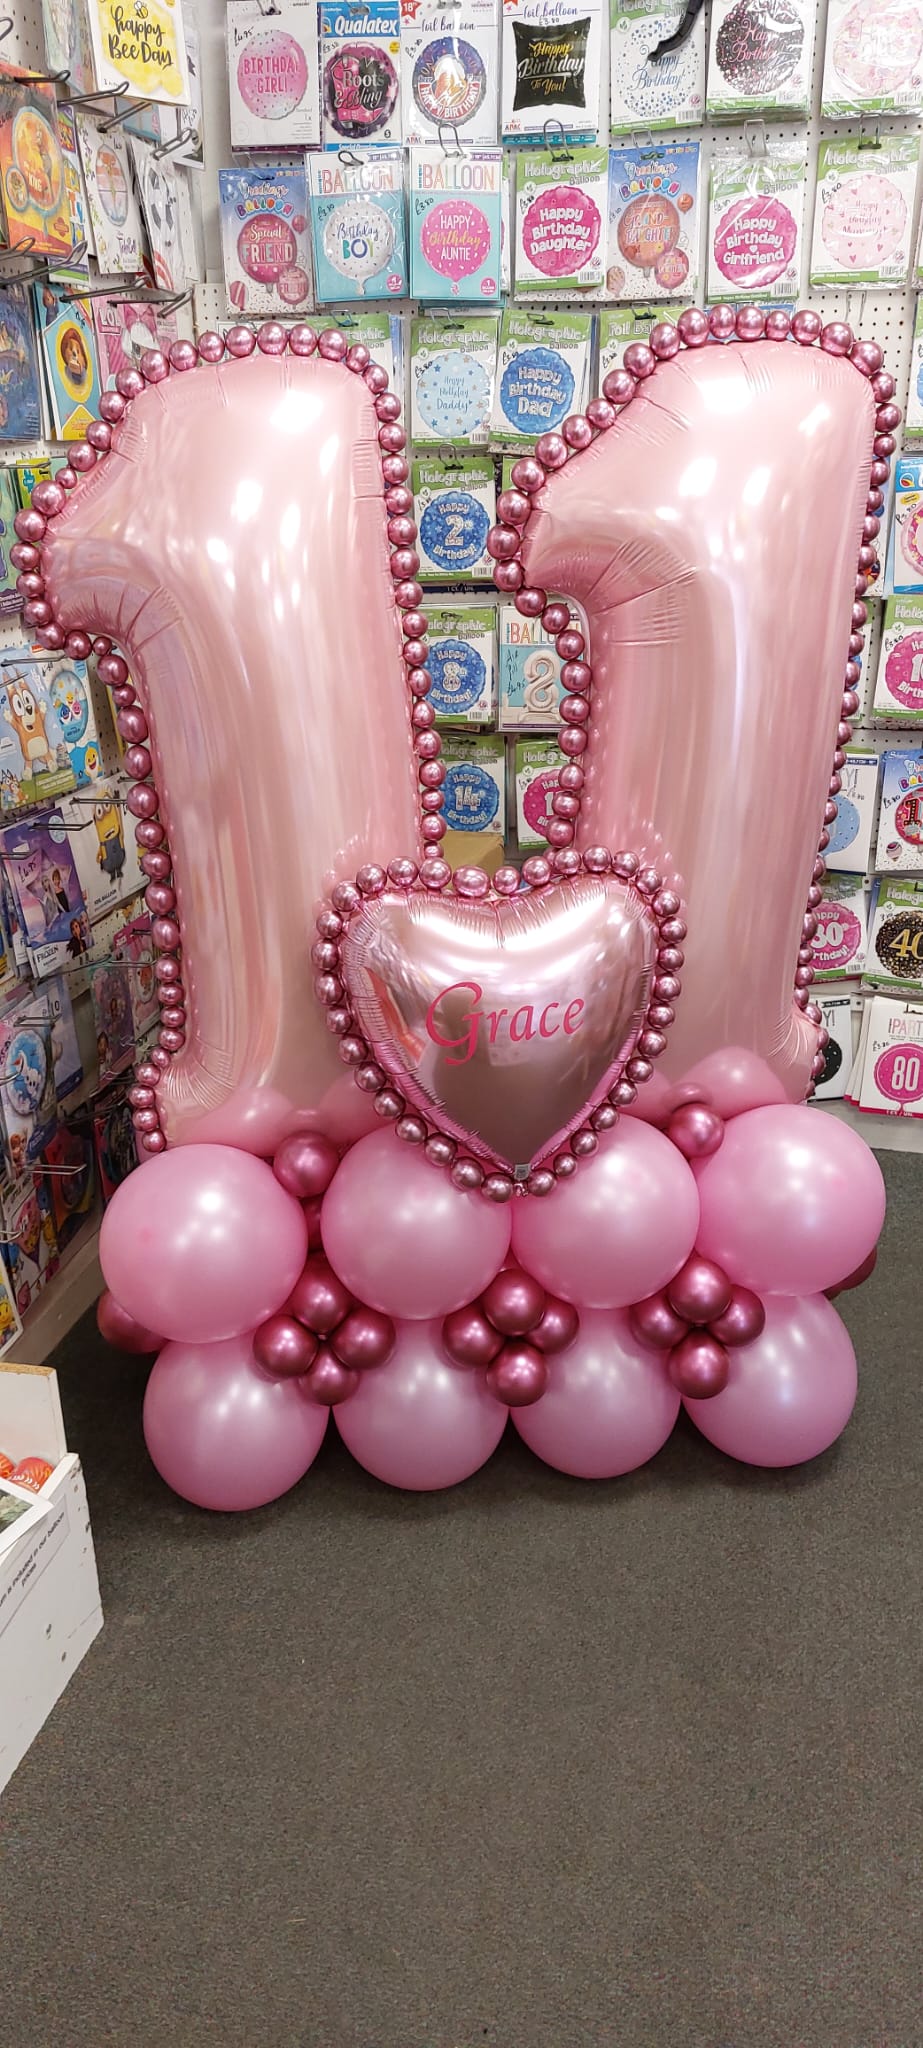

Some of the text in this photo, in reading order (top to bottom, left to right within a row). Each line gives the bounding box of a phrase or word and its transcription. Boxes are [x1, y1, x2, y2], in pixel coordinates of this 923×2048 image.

[542, 2, 578, 16] balloon
[110, 5, 166, 47] happy
[334, 14, 398, 37] Qualatex
[108, 33, 174, 70] Bee Day
[528, 42, 574, 58] Happy
[518, 55, 585, 79] Birthday
[257, 76, 288, 94] GIRL!
[343, 69, 385, 88] Boots
[543, 77, 567, 96] You!
[422, 163, 495, 191] BALLOON
[524, 160, 601, 180] Holographic
[569, 175, 601, 186] Balloon
[619, 176, 681, 199] BALLOON
[236, 197, 294, 217] BALLOON
[540, 207, 584, 222] Happy
[337, 222, 379, 241] Birthday
[440, 214, 471, 230] HAPPY
[532, 222, 591, 240] Birthday
[734, 218, 777, 232] Happy
[249, 223, 282, 242] Special
[429, 229, 482, 250] Birthday
[726, 231, 784, 251] Birthday
[242, 242, 293, 263] FRIEND
[342, 238, 374, 259] BOY
[440, 246, 471, 261] AUNTIE
[530, 235, 592, 256] Daughter
[723, 248, 785, 266] Girlfriend
[418, 329, 490, 347] Holographic
[508, 319, 585, 342] Holographic
[609, 322, 631, 336] Foil
[460, 342, 490, 354] Balloon
[518, 366, 562, 386] Happy
[508, 382, 568, 405] Birthday
[517, 397, 553, 418] Dad
[419, 469, 489, 486] Holographic
[438, 502, 470, 515] Happy
[436, 649, 468, 661] Happy
[452, 773, 482, 785] Happy
[542, 779, 559, 790] Hap
[425, 981, 585, 1067] Grace
[891, 1055, 920, 1092] 80
